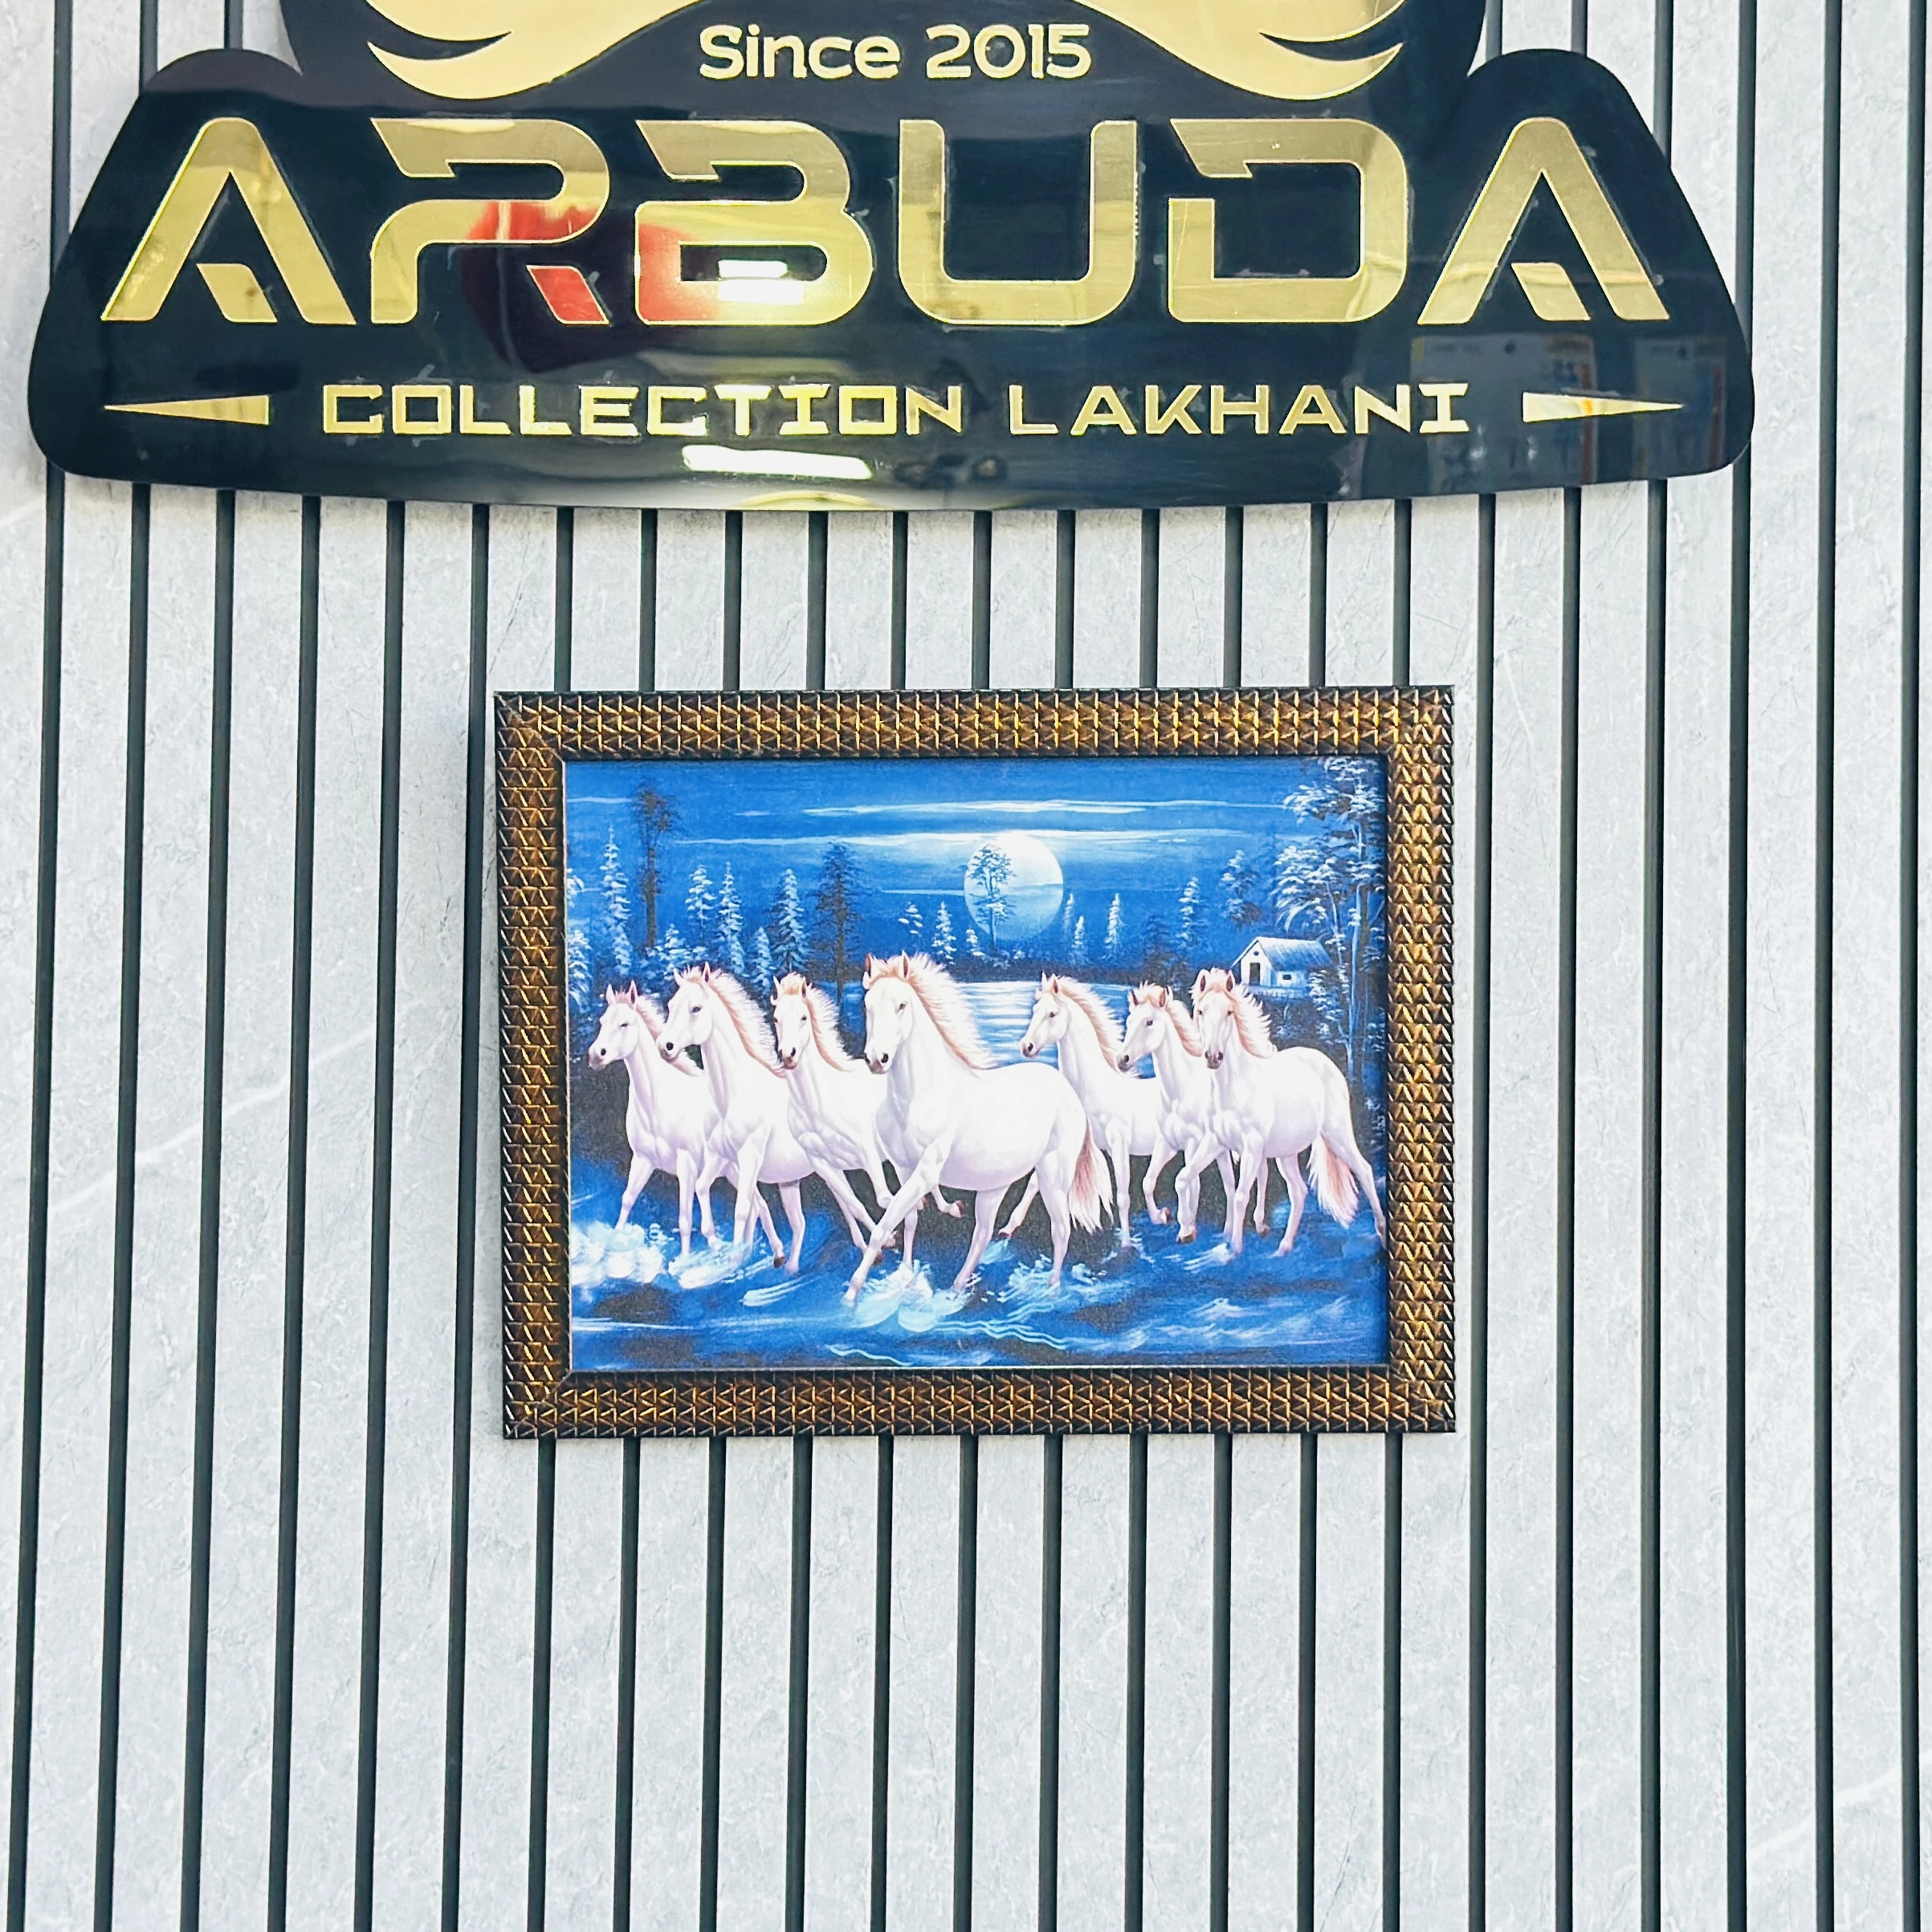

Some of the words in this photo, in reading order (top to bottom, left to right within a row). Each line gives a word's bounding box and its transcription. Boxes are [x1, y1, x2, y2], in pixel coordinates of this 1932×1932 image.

[699, 24, 901, 79] Since
[926, 23, 1093, 79] 2015
[100, 117, 1670, 326] ARBUDA
[322, 383, 962, 438] COLLECTION
[1009, 381, 1469, 437] LAKHANI
